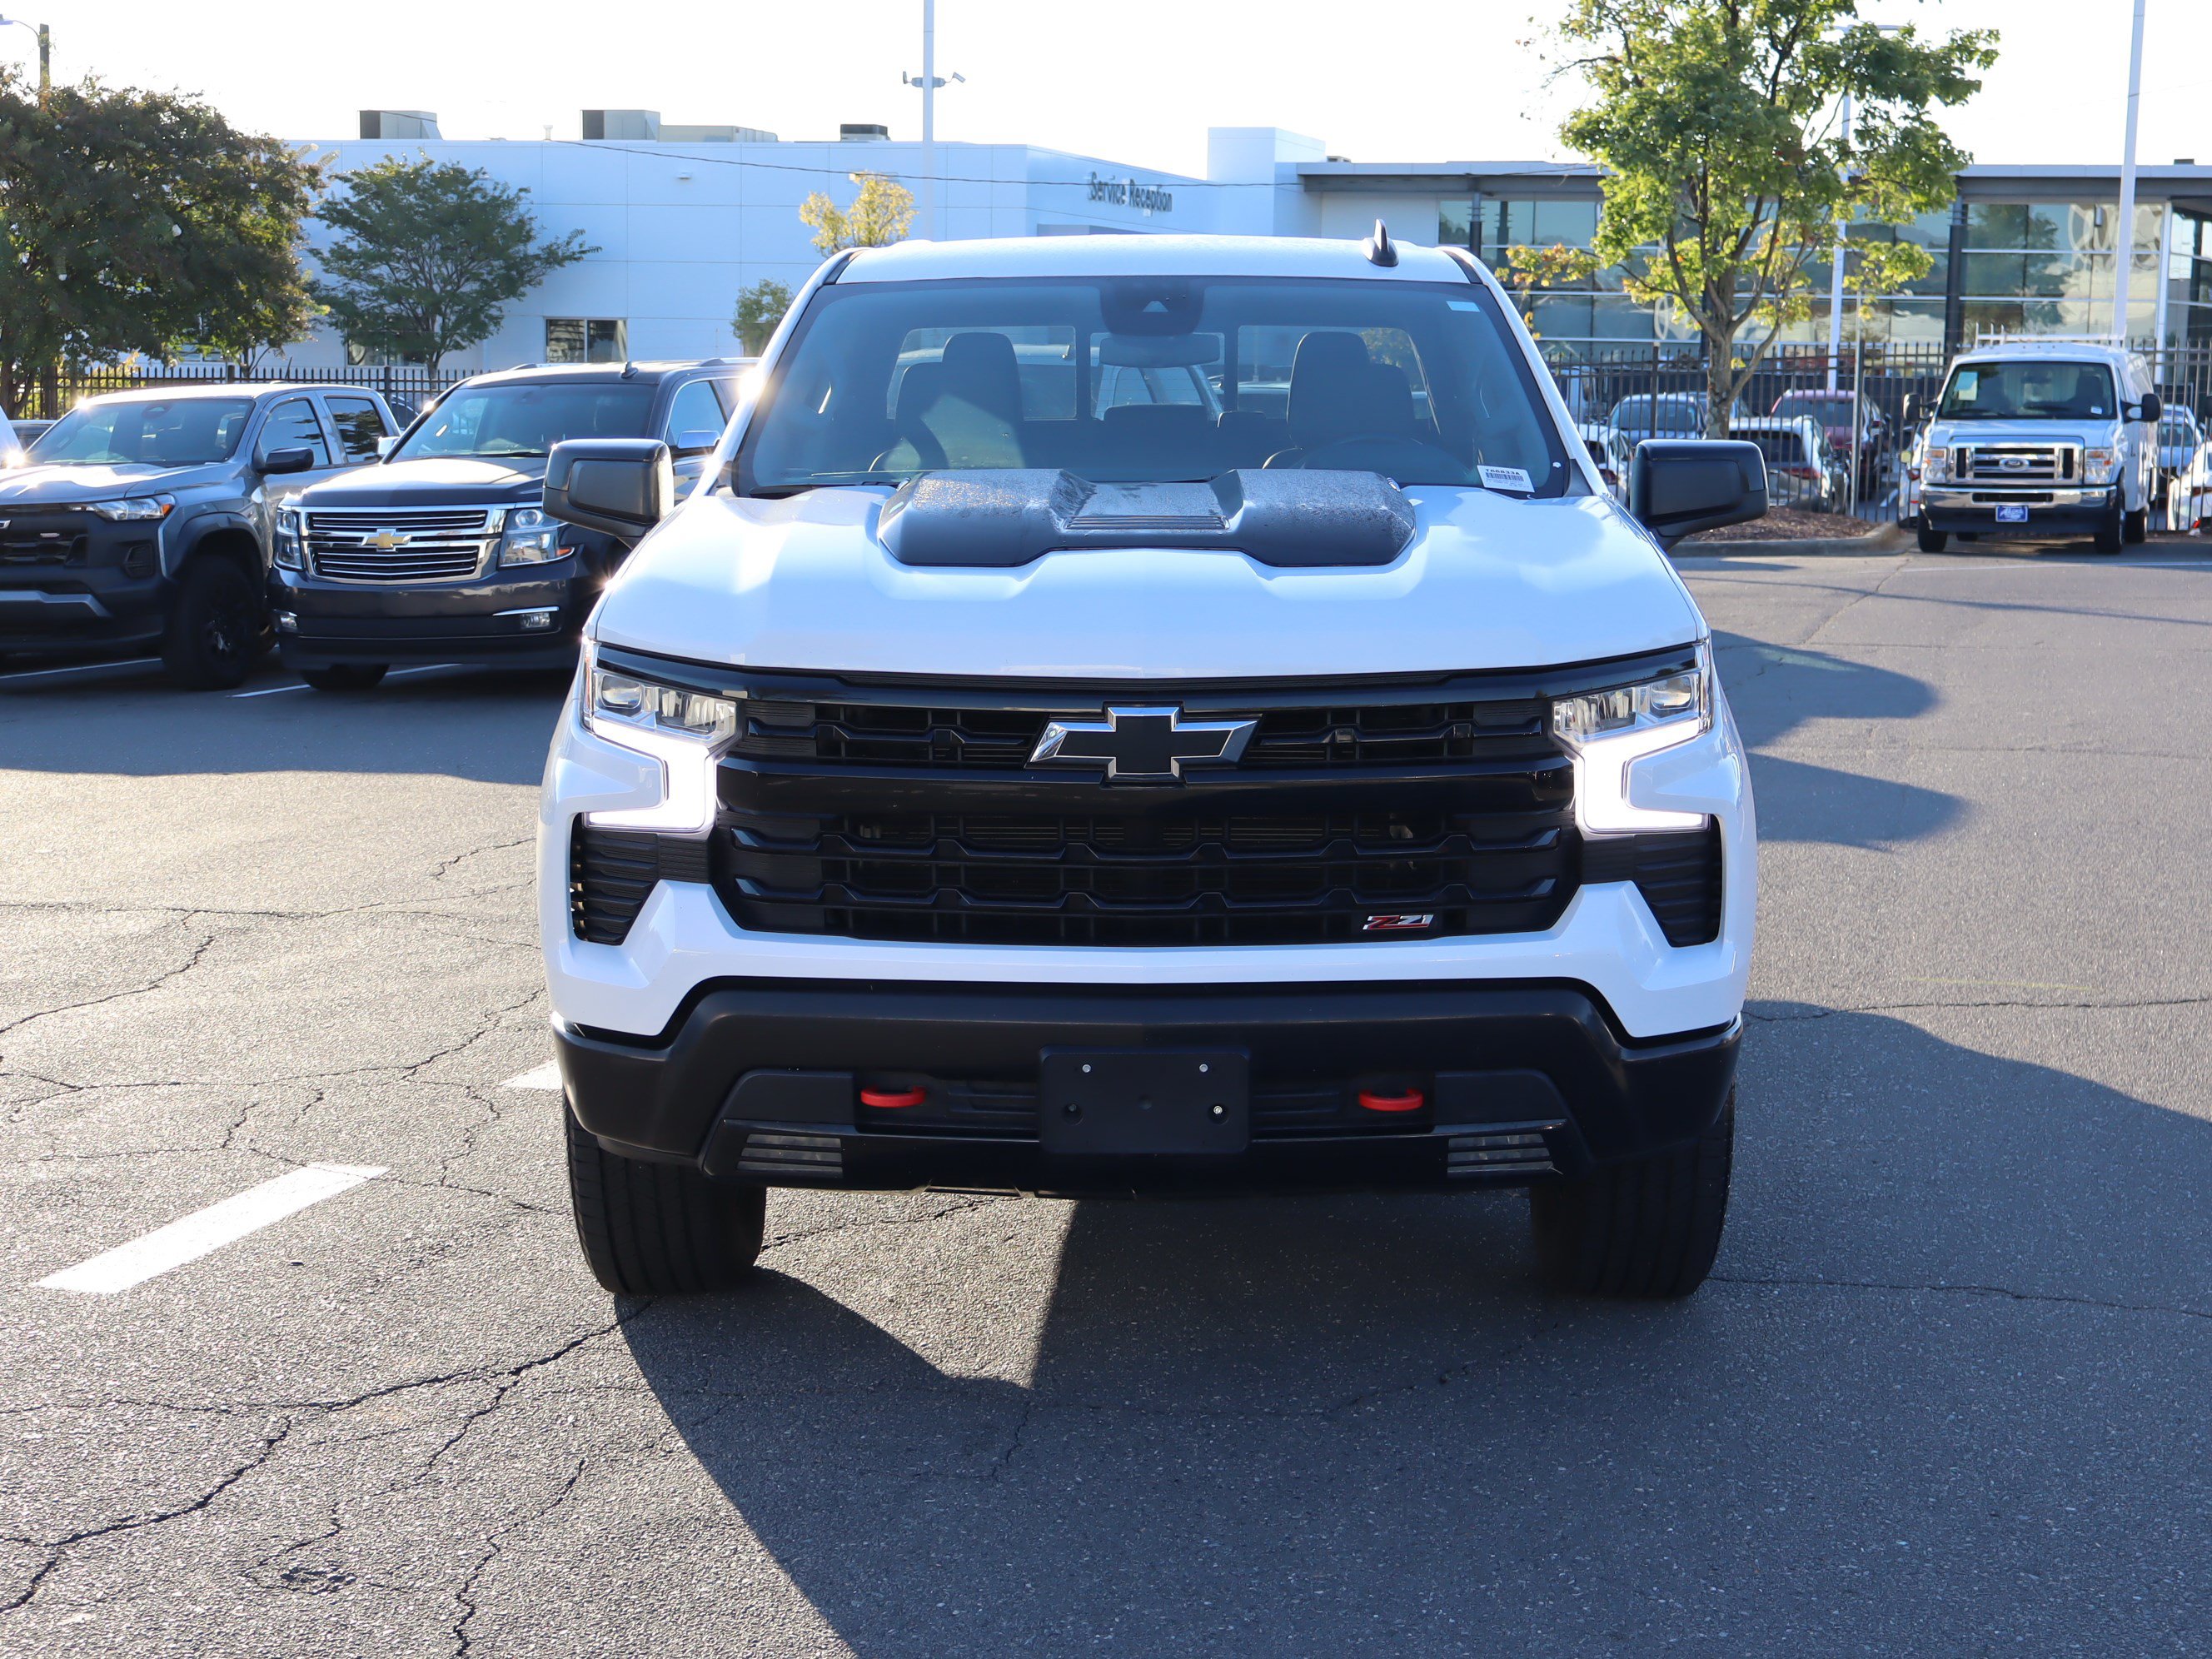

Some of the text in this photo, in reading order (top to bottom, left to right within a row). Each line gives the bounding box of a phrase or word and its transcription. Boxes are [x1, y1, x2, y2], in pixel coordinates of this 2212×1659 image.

[1090, 171, 1173, 217] Service Reception
[1363, 914, 1433, 929] Z71
